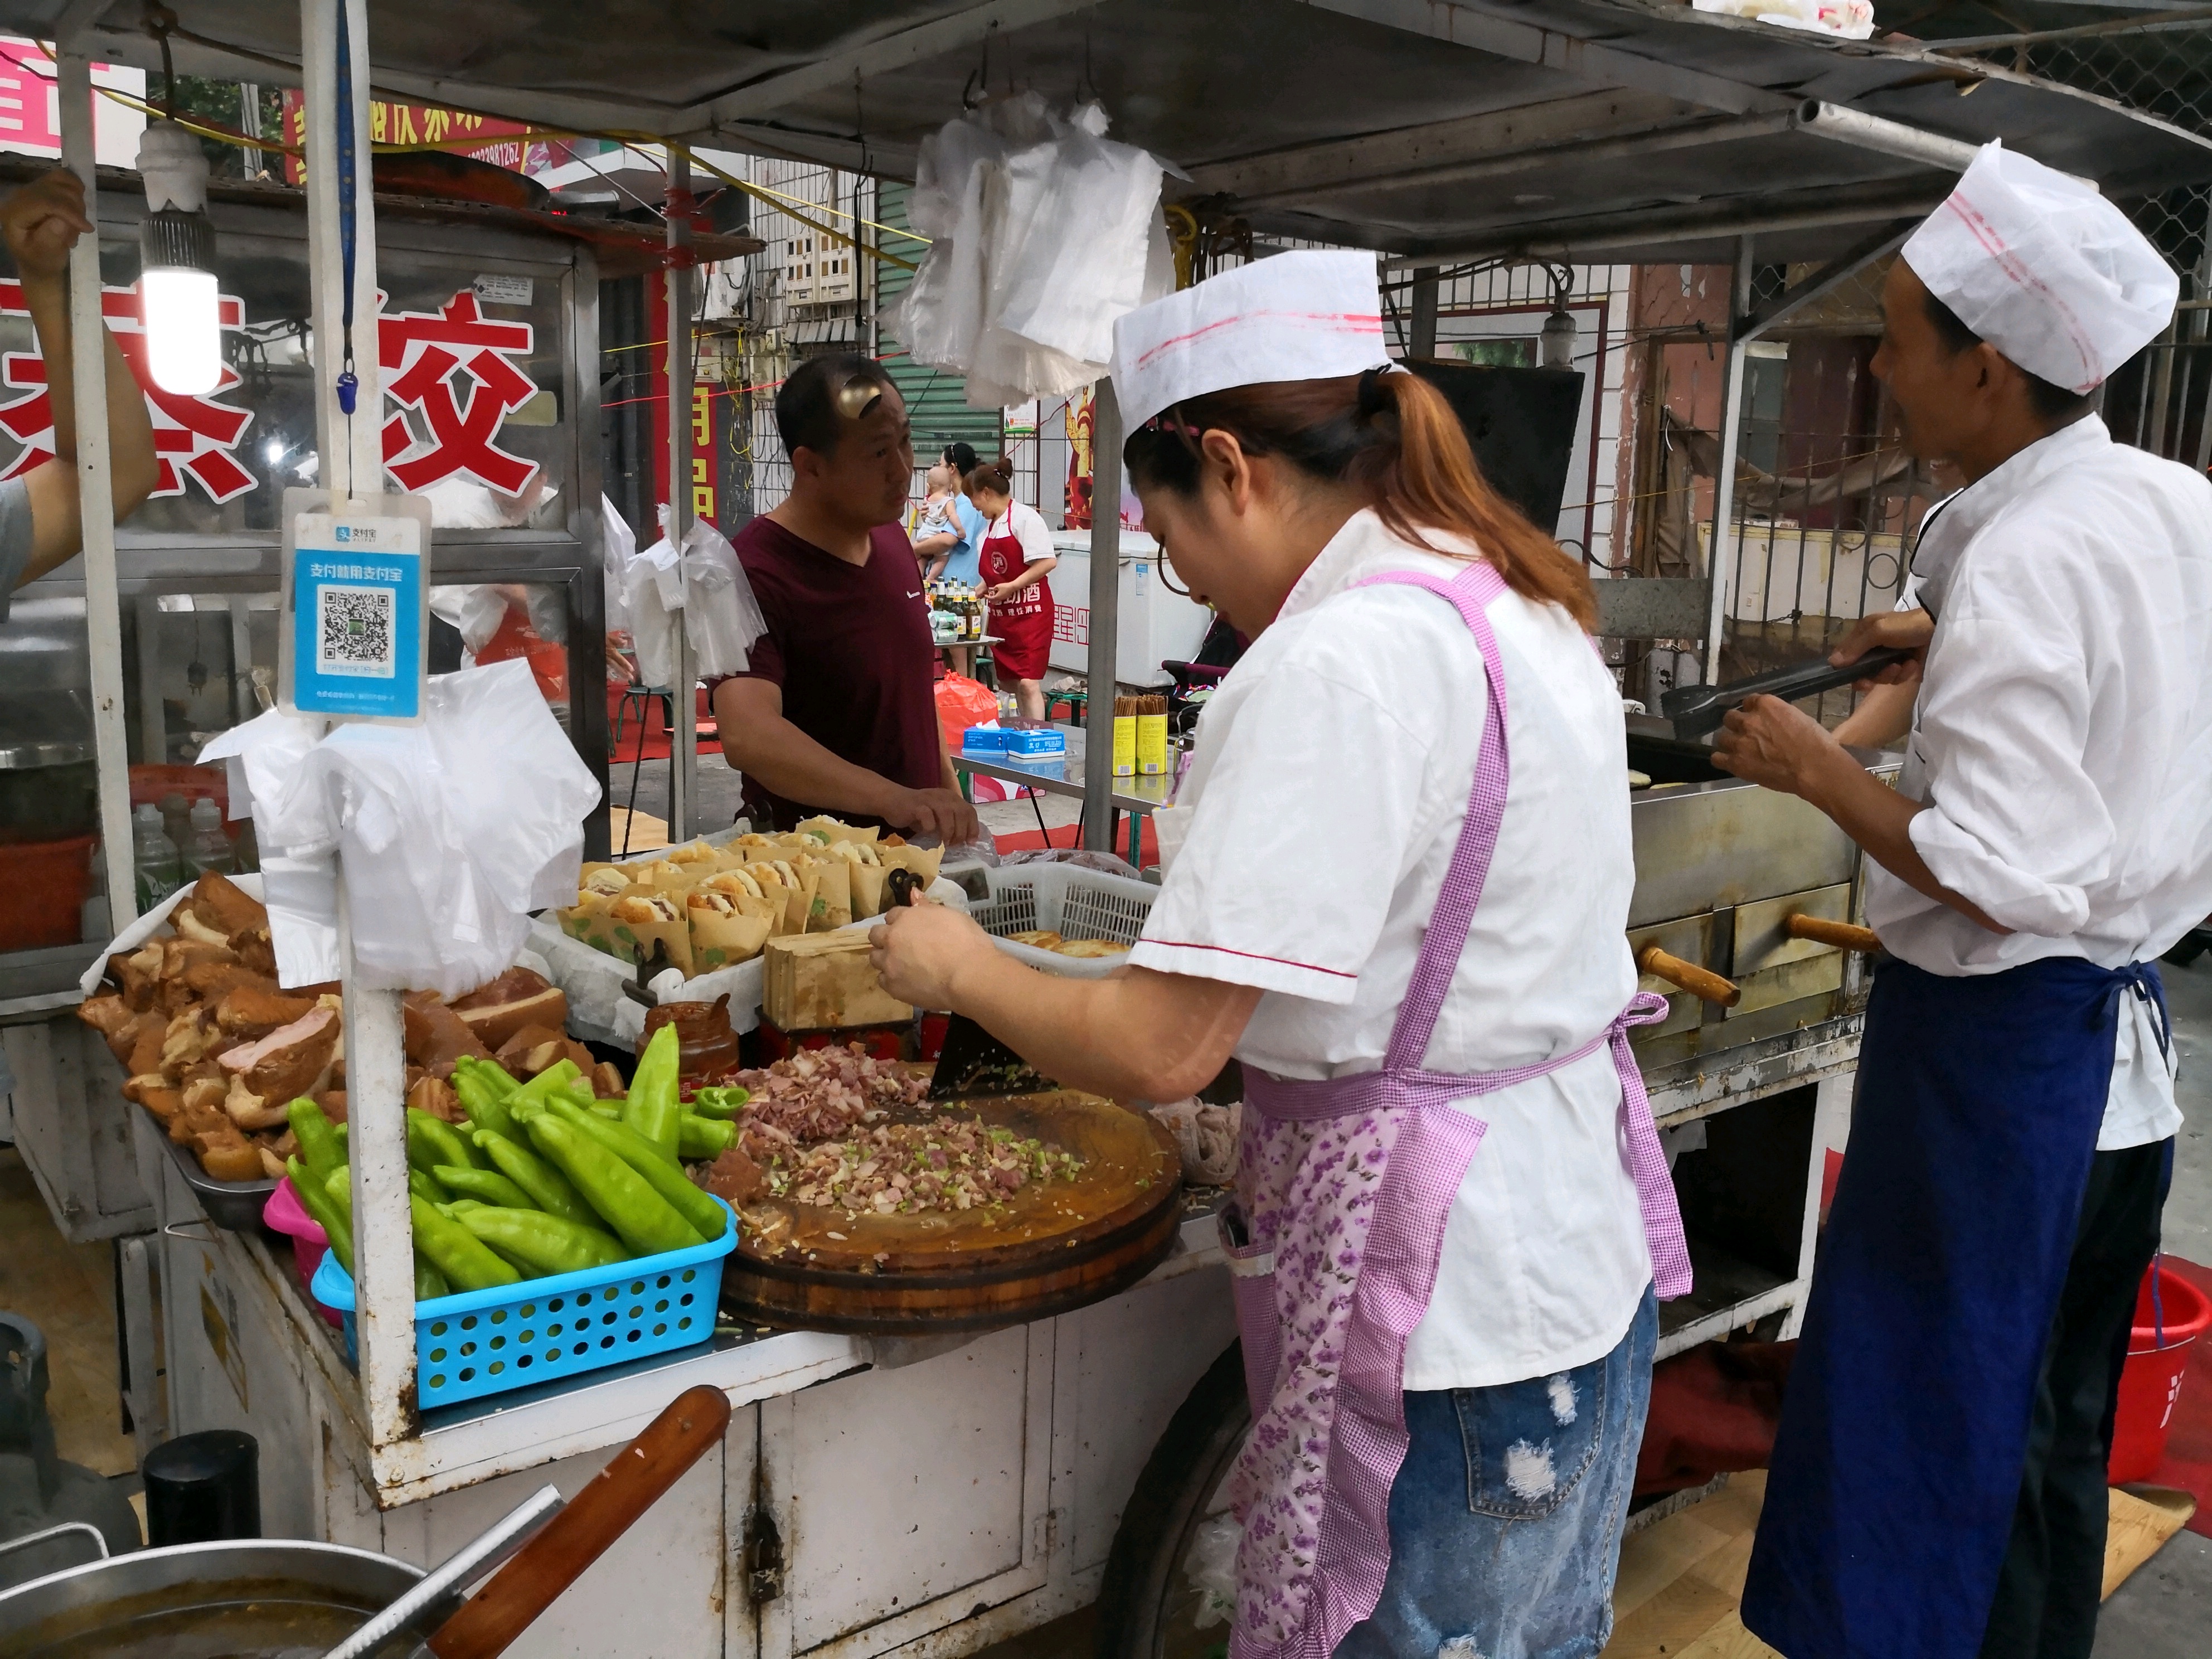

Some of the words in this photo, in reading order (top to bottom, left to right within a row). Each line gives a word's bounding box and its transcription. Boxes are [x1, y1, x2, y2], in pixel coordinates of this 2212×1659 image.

[352, 528, 376, 538] 支付宝
[311, 563, 402, 582] 支付就用支付宝
